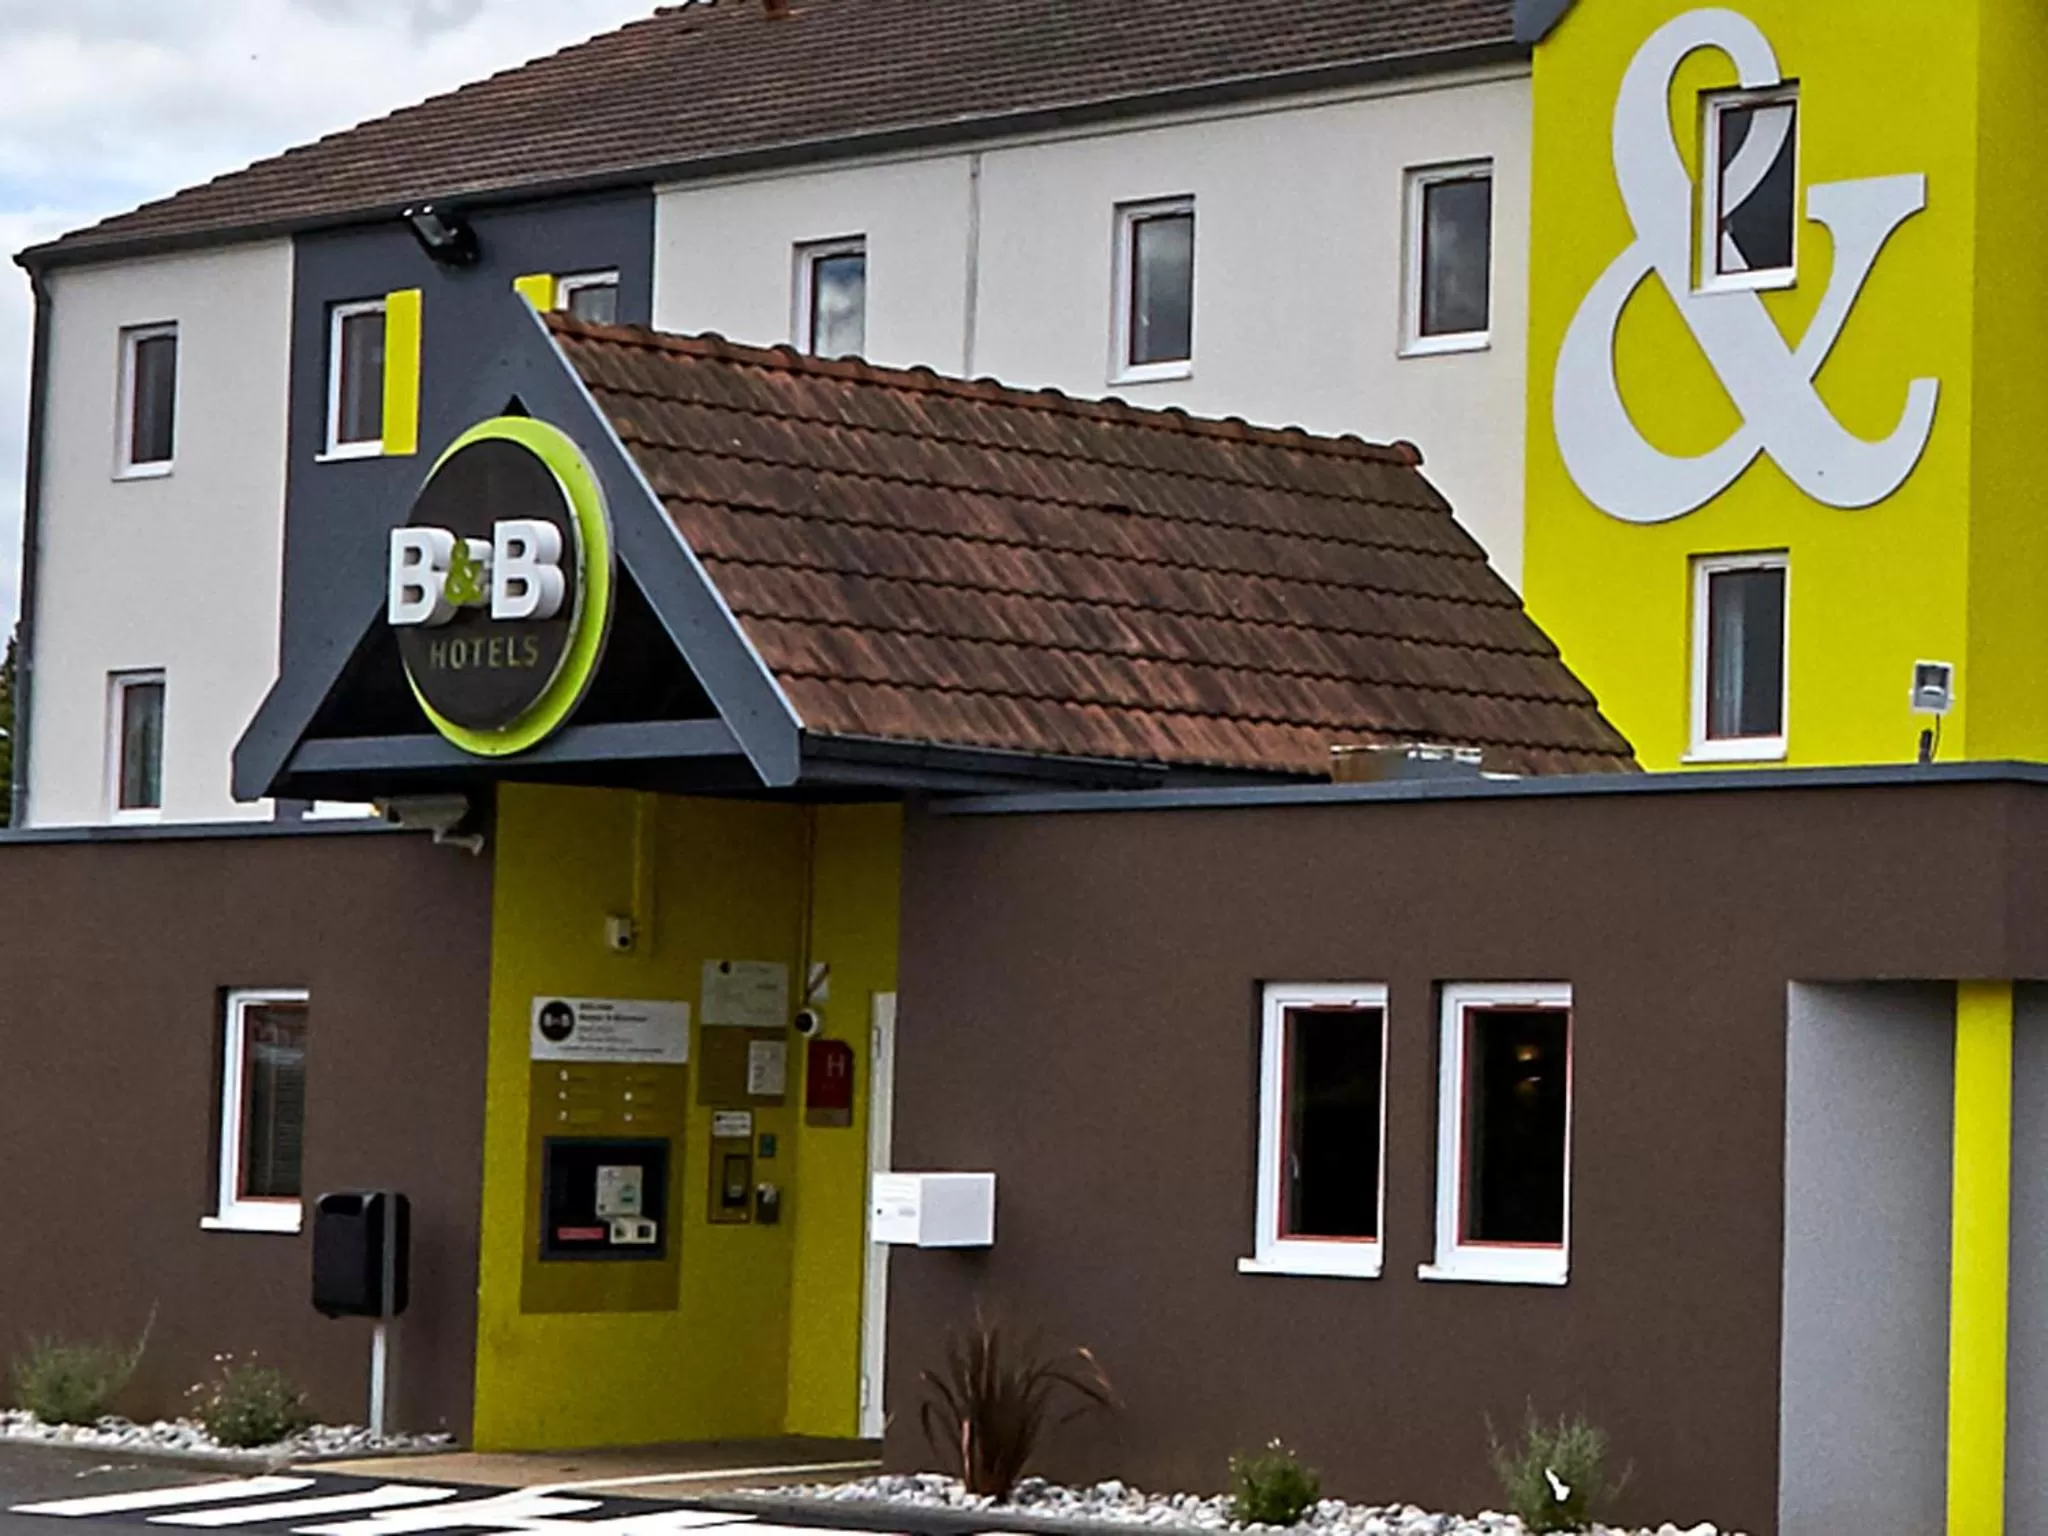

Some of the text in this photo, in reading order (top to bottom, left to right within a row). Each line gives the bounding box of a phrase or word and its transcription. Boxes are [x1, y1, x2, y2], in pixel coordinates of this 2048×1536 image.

[1553, 7, 1937, 523] &
[388, 519, 566, 625] B&B
[430, 636, 539, 668] HOTELS
[826, 1053, 847, 1077] H
